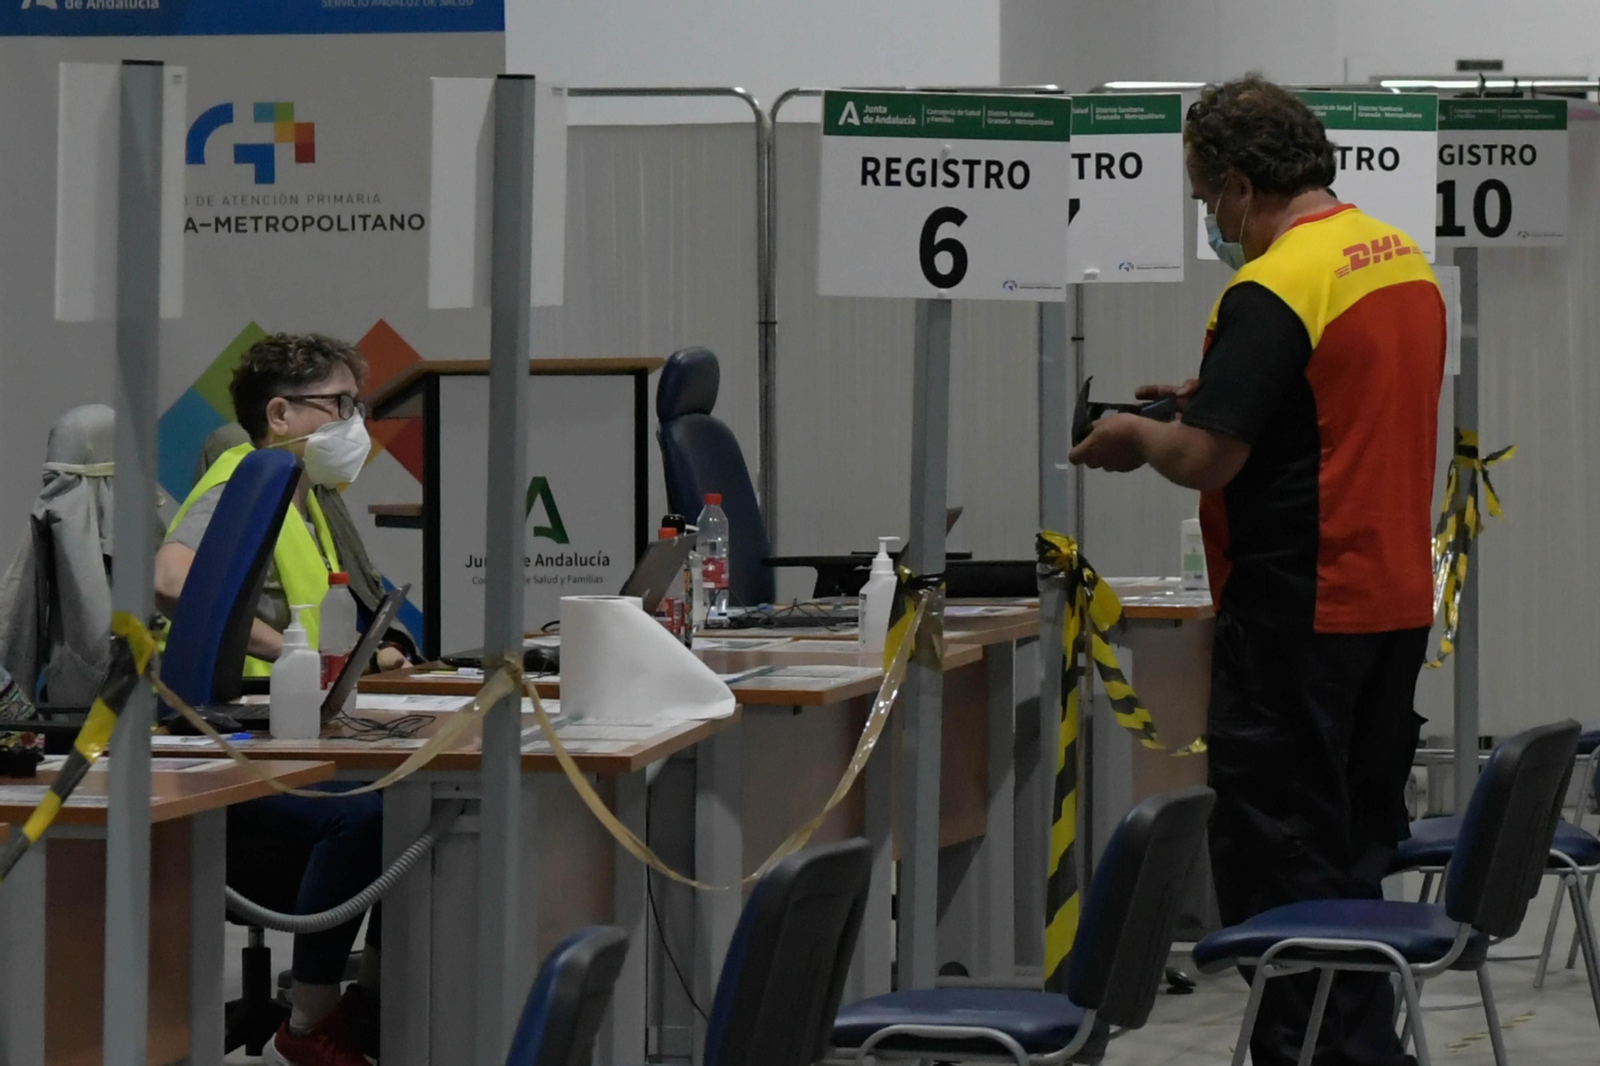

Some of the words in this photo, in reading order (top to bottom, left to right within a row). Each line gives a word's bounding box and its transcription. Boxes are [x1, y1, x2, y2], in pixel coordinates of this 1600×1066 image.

[863, 104, 888, 114] Junta
[863, 115, 874, 124] de
[861, 156, 1031, 190] REGISTRO
[196, 194, 214, 206] DE
[222, 191, 300, 206] ATENCIÓN
[307, 192, 382, 205] PRIMARIA
[1436, 178, 1513, 239] 10
[919, 206, 969, 289] 6
[1342, 234, 1412, 272] DHL
[535, 551, 611, 568] Andalucía
[533, 575, 558, 585] Salud
[567, 574, 604, 585] Familias
